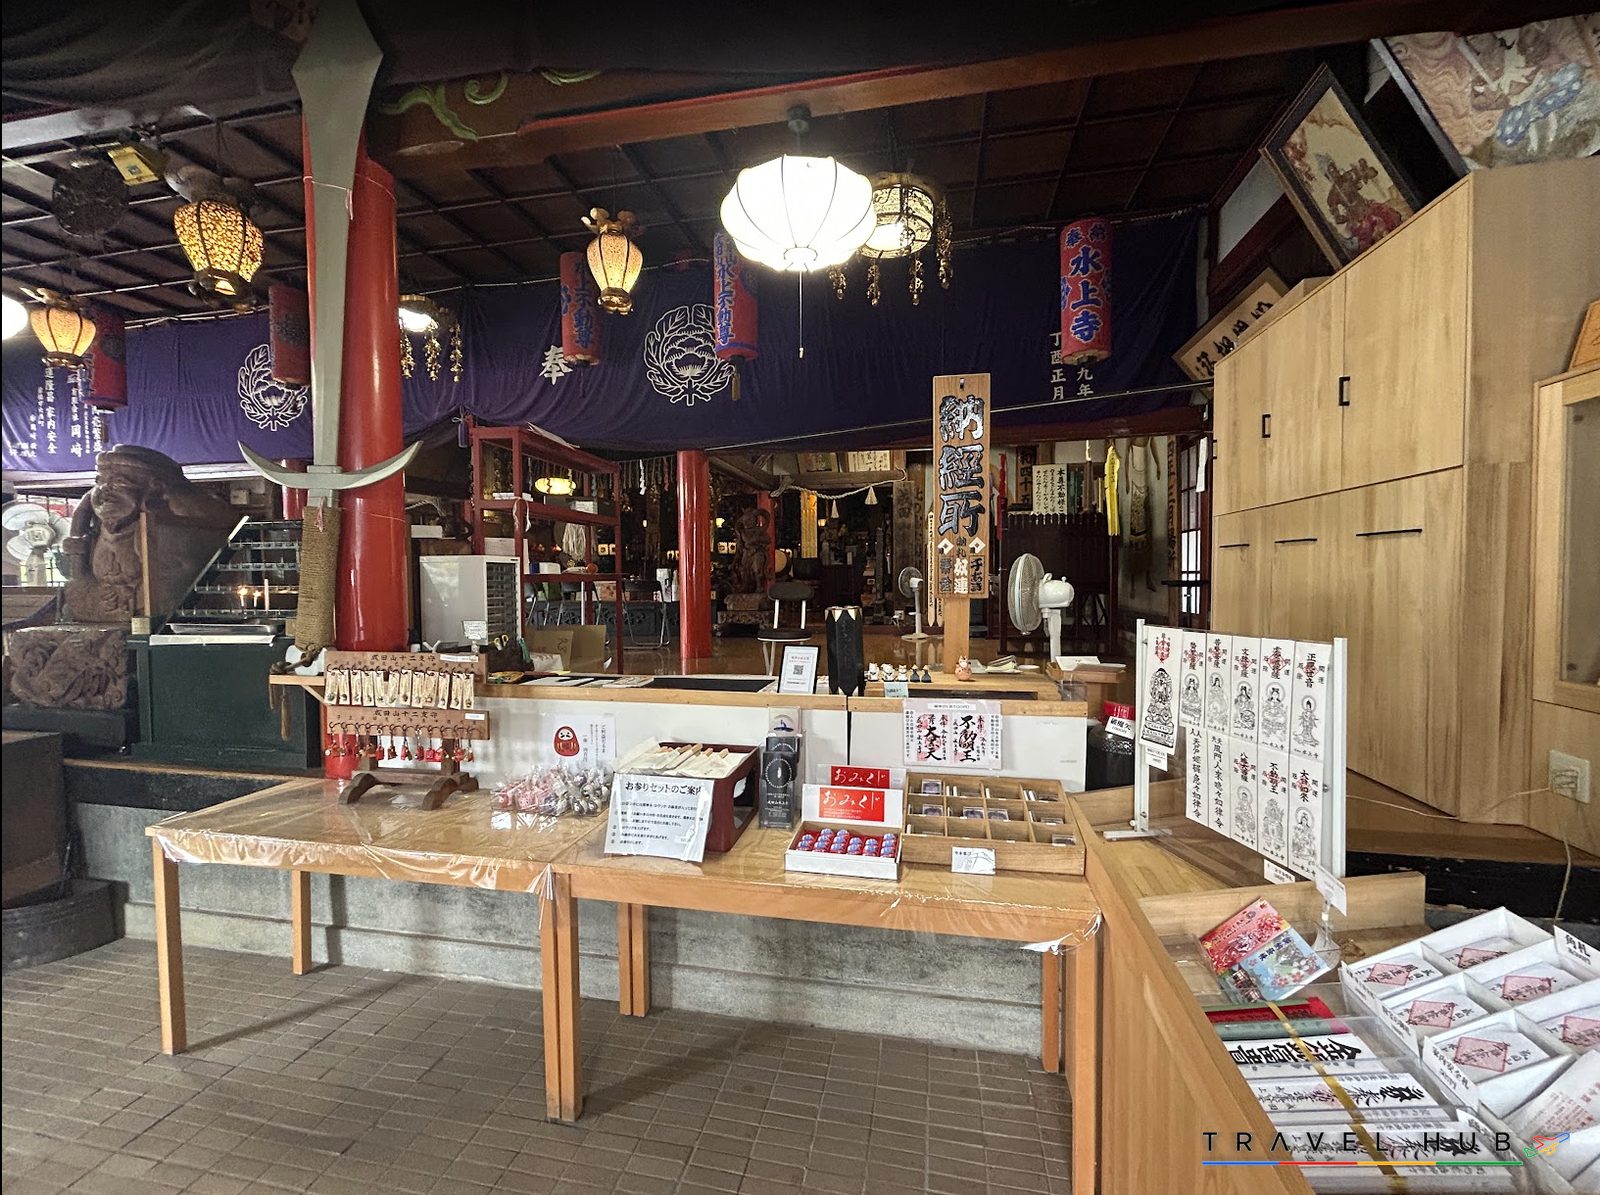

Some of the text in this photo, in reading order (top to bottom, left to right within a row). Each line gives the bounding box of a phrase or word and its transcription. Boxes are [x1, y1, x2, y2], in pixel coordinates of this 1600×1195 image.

[1069, 245, 1103, 342] 水上寺
[539, 345, 573, 385] 奉
[938, 394, 986, 537] 納経所
[834, 768, 887, 786] おみくじ
[823, 790, 881, 810] おみくじ
